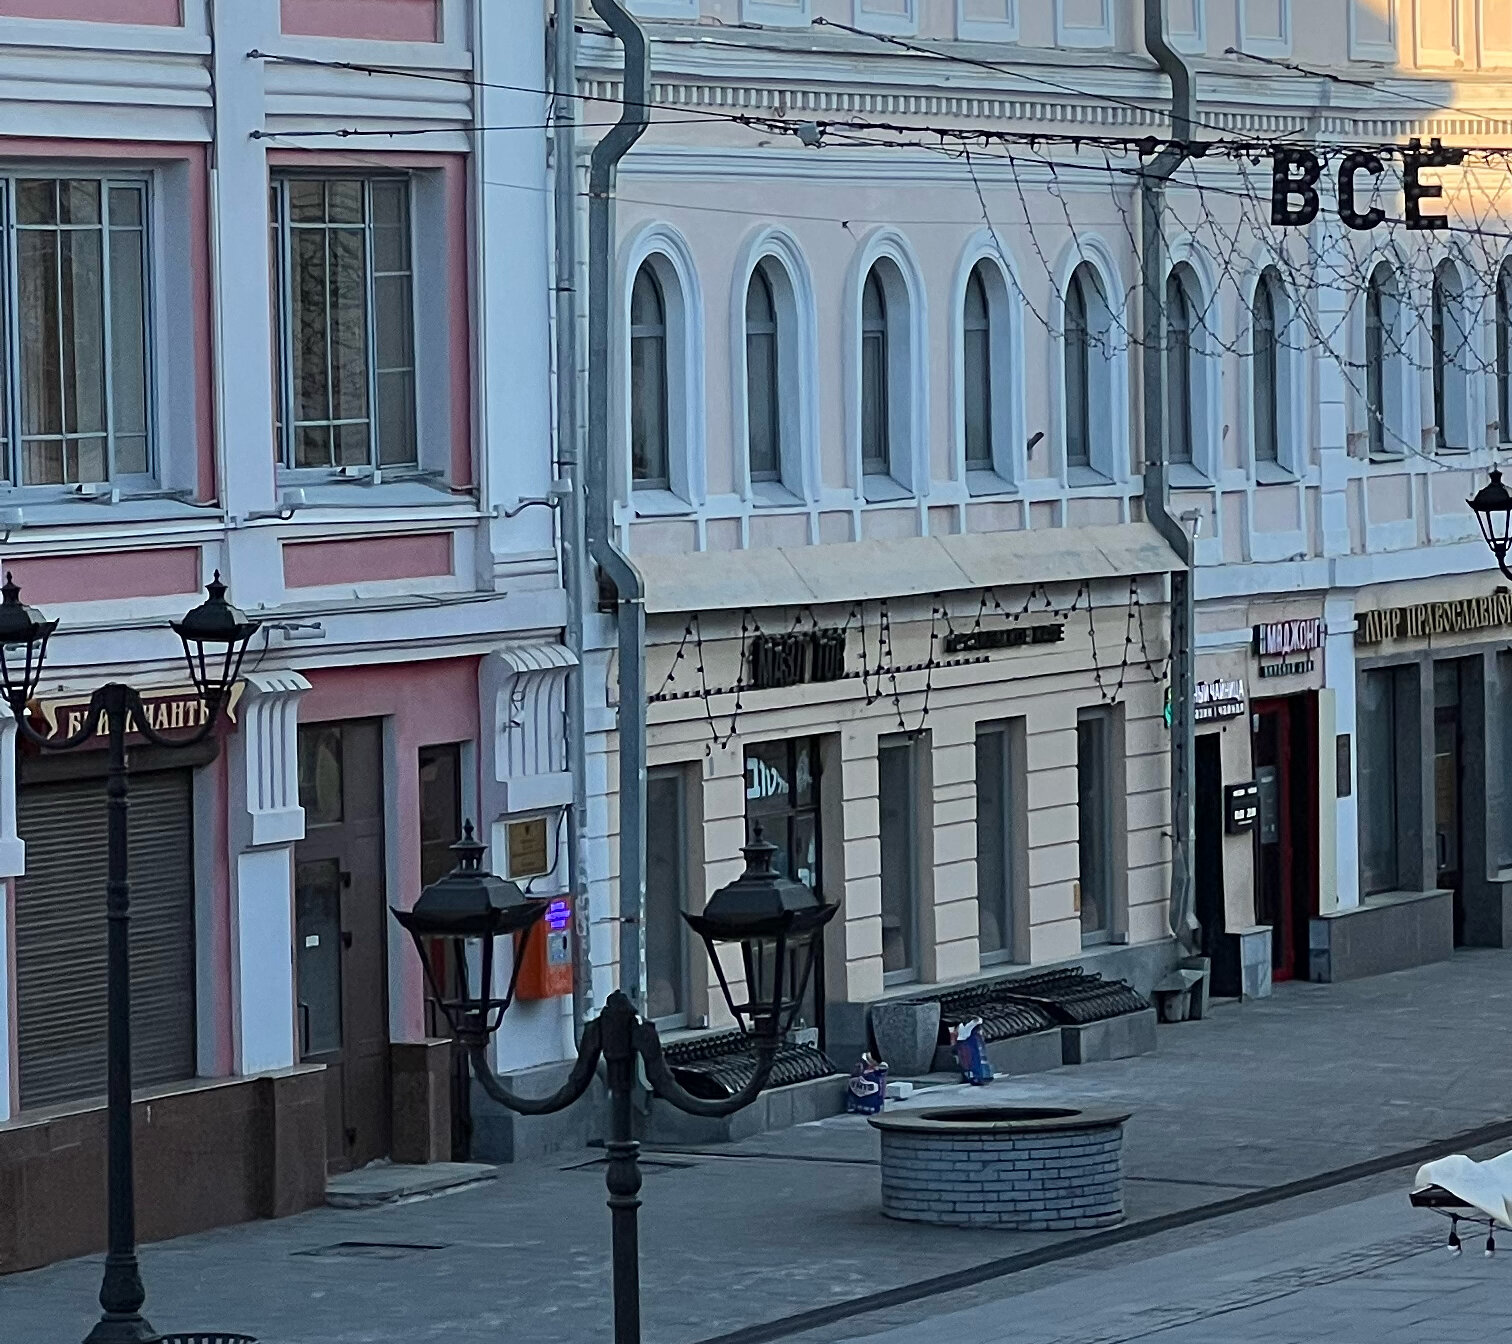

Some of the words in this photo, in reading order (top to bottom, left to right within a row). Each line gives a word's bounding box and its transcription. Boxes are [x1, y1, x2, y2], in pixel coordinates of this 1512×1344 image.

[1271, 138, 1456, 230] ВСЁ
[1267, 619, 1320, 656] МАДЖОНГ
[1365, 609, 1400, 643] МИР
